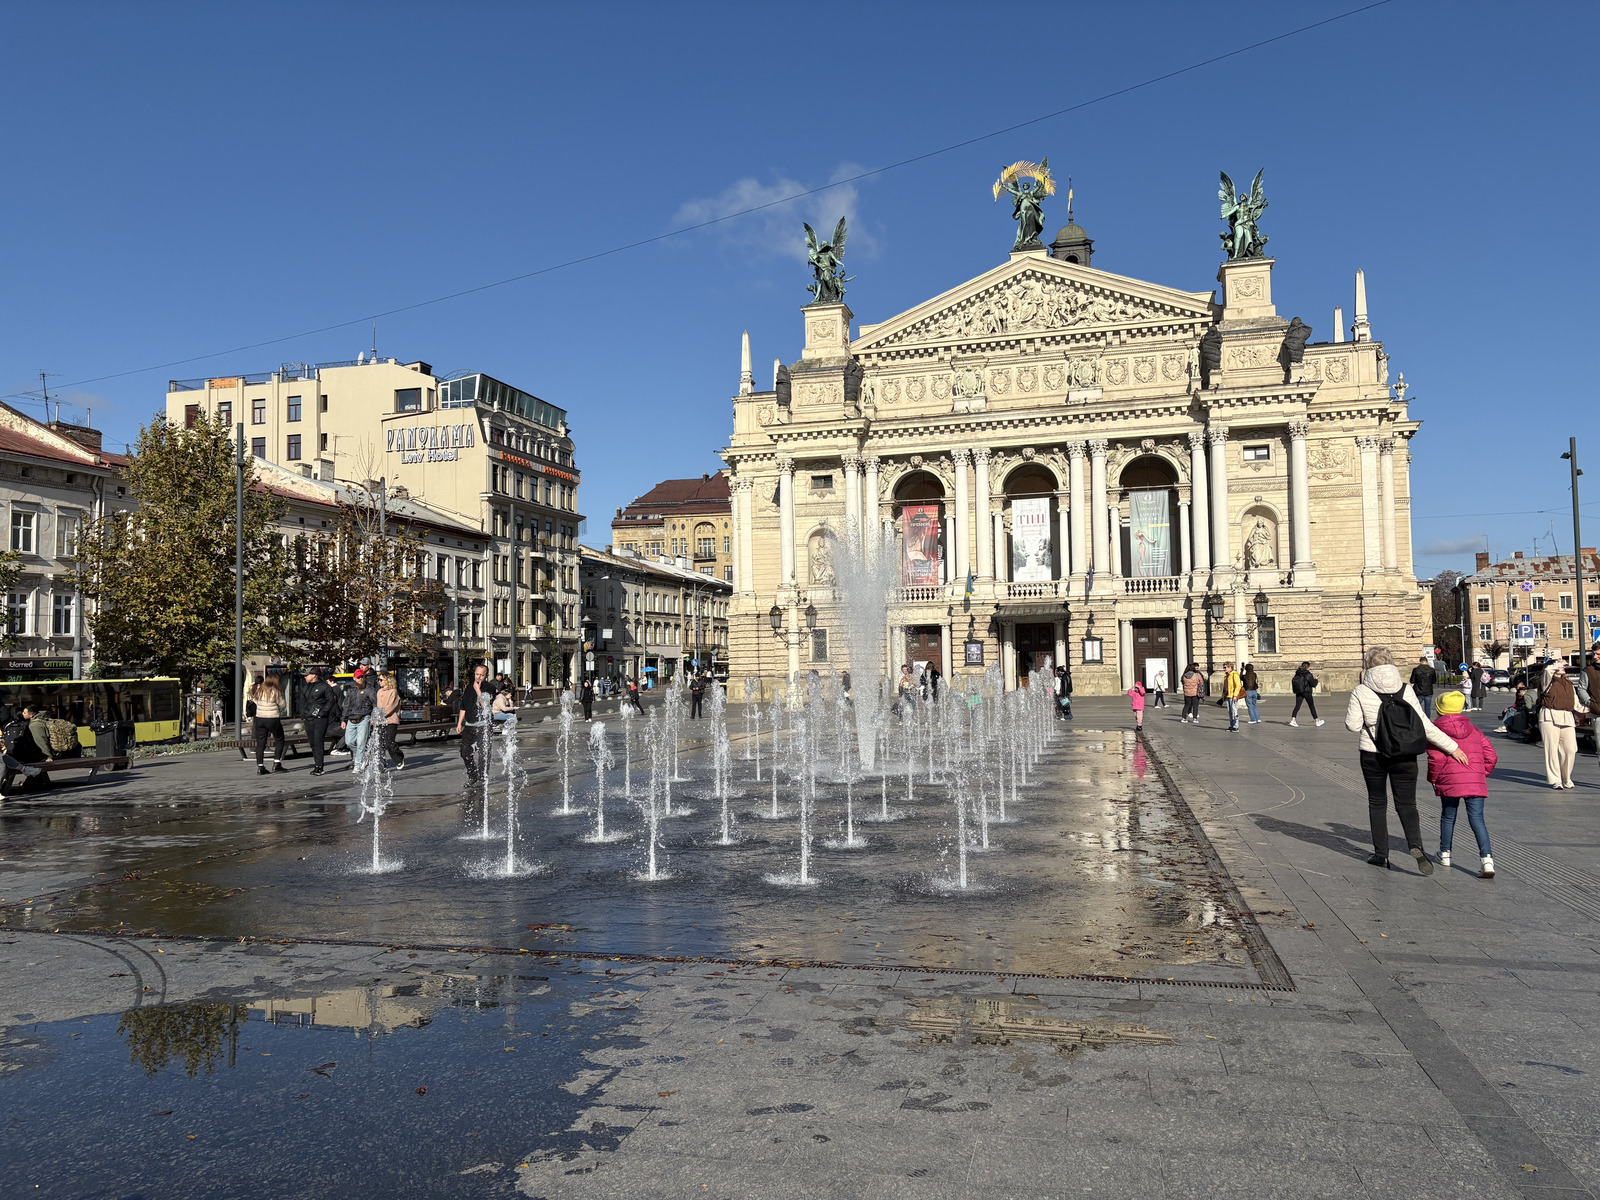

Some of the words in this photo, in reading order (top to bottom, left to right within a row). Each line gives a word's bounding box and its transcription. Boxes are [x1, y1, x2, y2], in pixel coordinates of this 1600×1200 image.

[386, 424, 474, 452] PANORAMA
[401, 451, 424, 464] Lviv
[427, 449, 458, 463] Hotel
[1521, 625, 1531, 638] P
